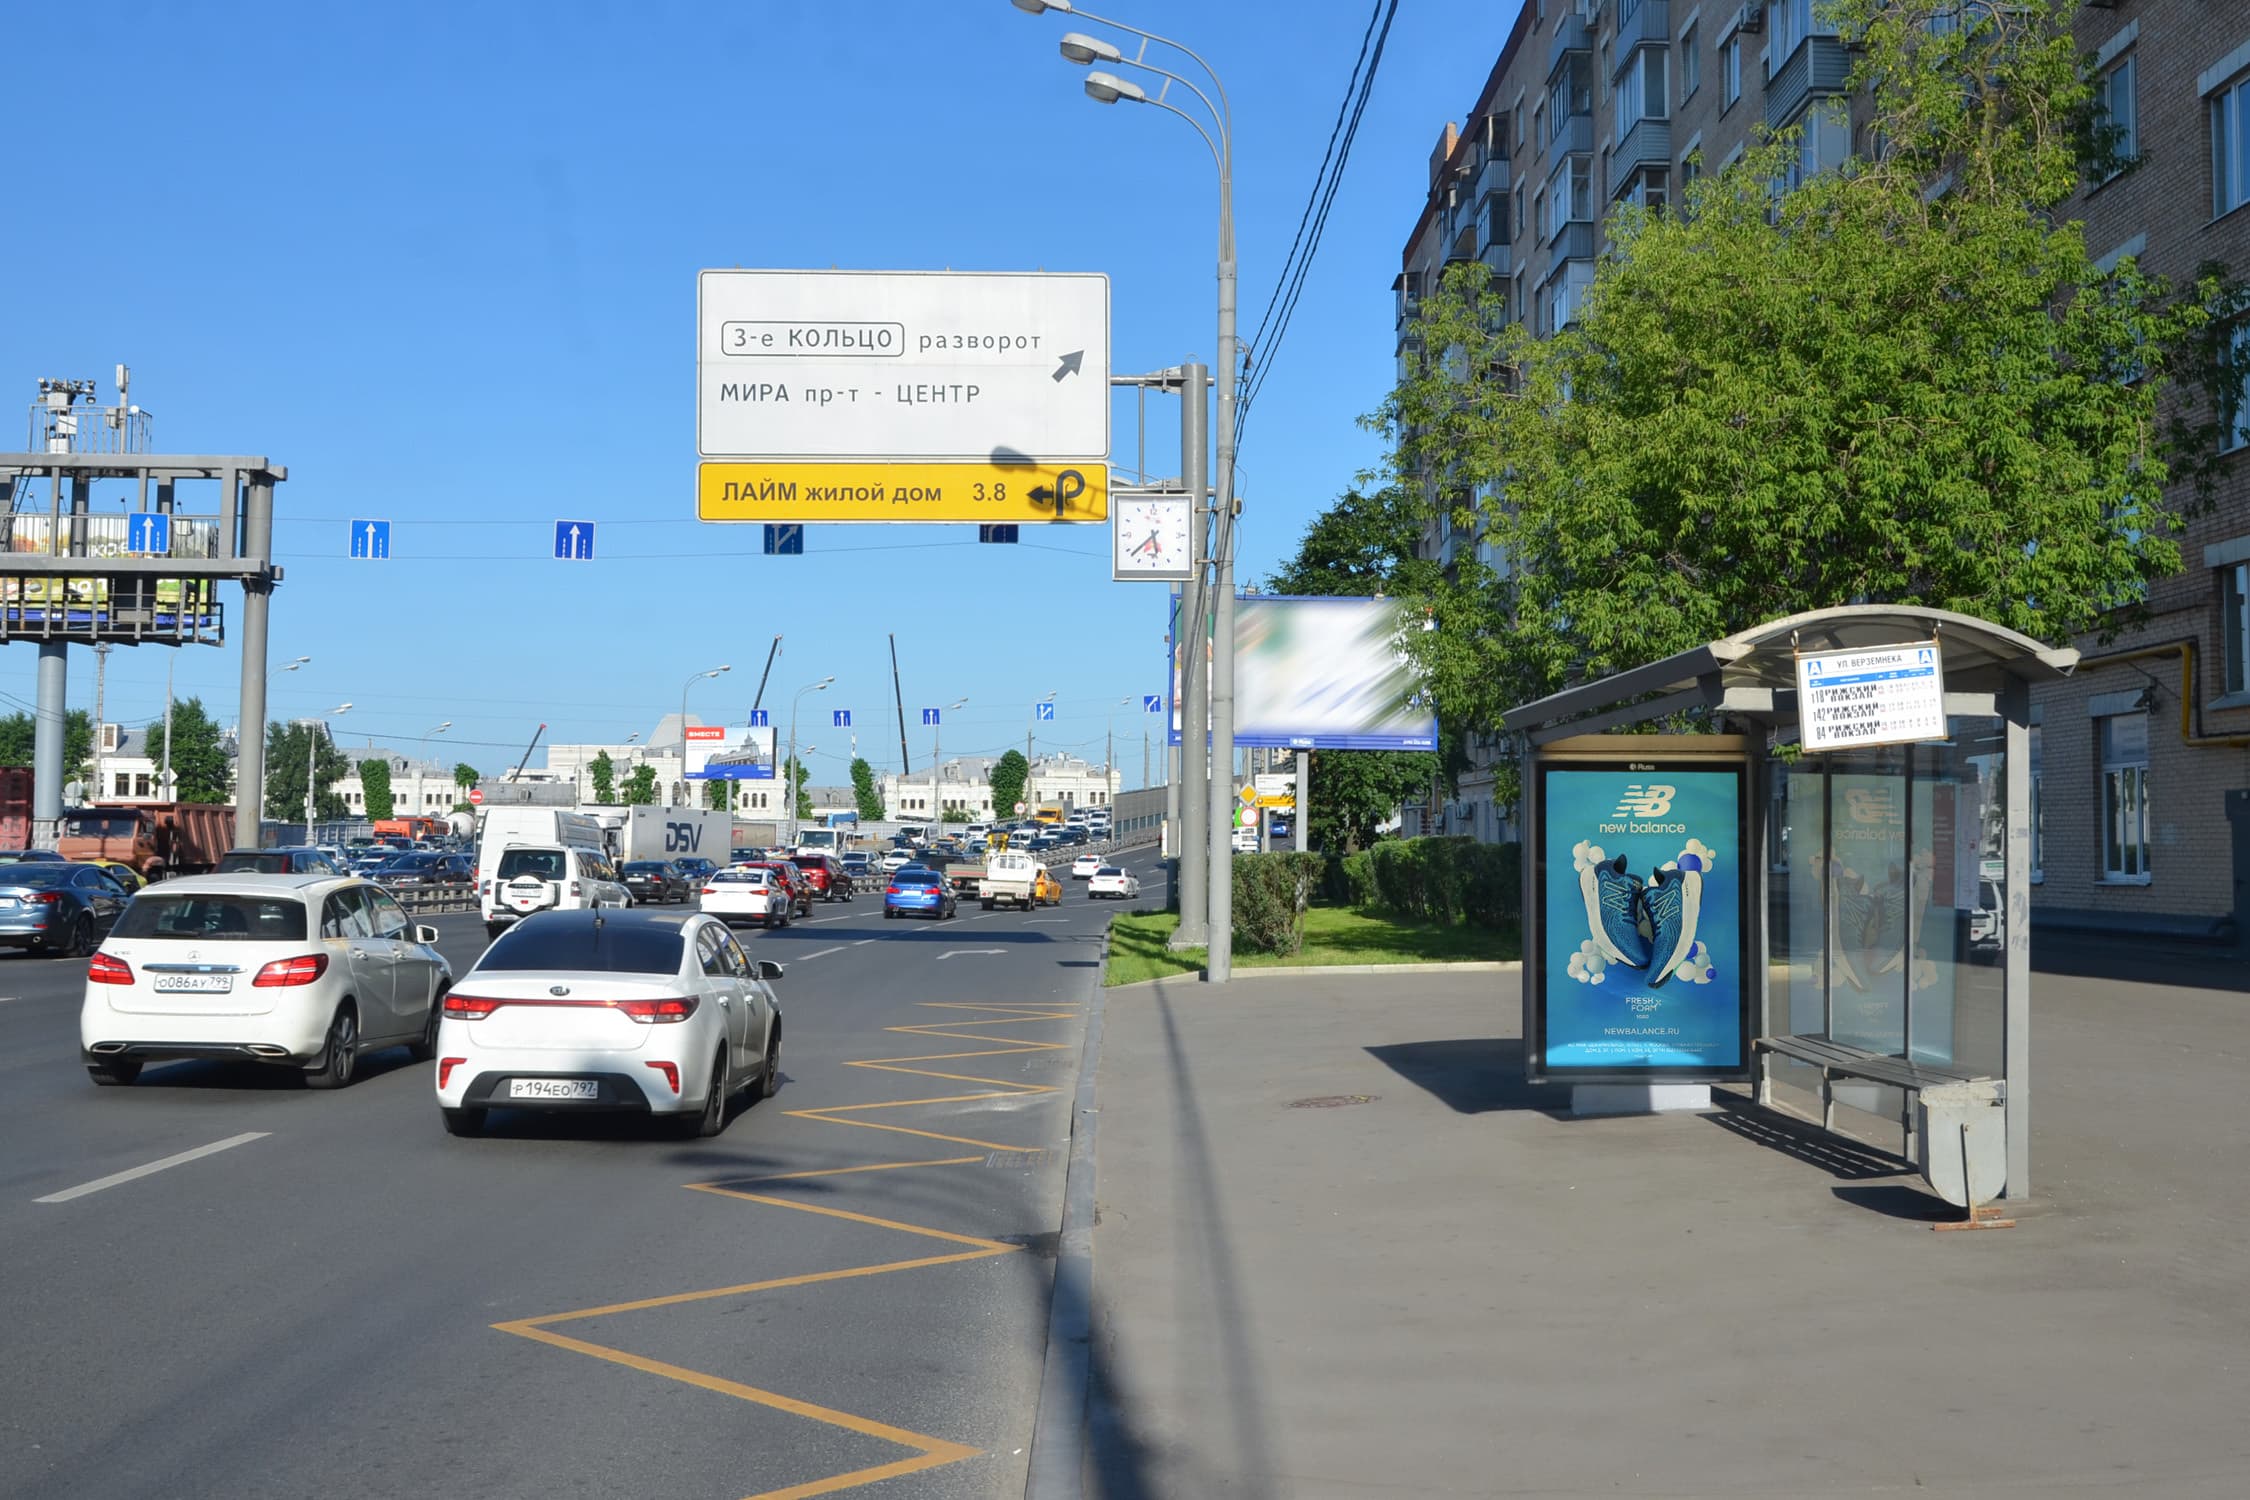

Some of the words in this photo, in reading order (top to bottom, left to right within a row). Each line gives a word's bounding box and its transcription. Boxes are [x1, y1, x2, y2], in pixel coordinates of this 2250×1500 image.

[733, 328, 774, 348] 3-е
[789, 328, 892, 351] КОЛЬЦО
[919, 335, 1041, 354] разворот
[720, 383, 790, 402] МИРА
[805, 388, 859, 407] пр-т
[897, 384, 981, 406] ЦЕНТР
[722, 478, 798, 501] ЛАЙМ
[805, 482, 885, 502] жилой
[892, 486, 942, 504] дом
[972, 482, 1007, 501] 3.8
[1850, 654, 1903, 668] ВЕРЗЕМНЕКА
[1599, 823, 1627, 833] new
[1630, 821, 1686, 833] balance
[665, 822, 703, 853] DSV
[1625, 996, 1654, 1005] FRESH
[1604, 1027, 1680, 1036] NEWBALANCE.RU
